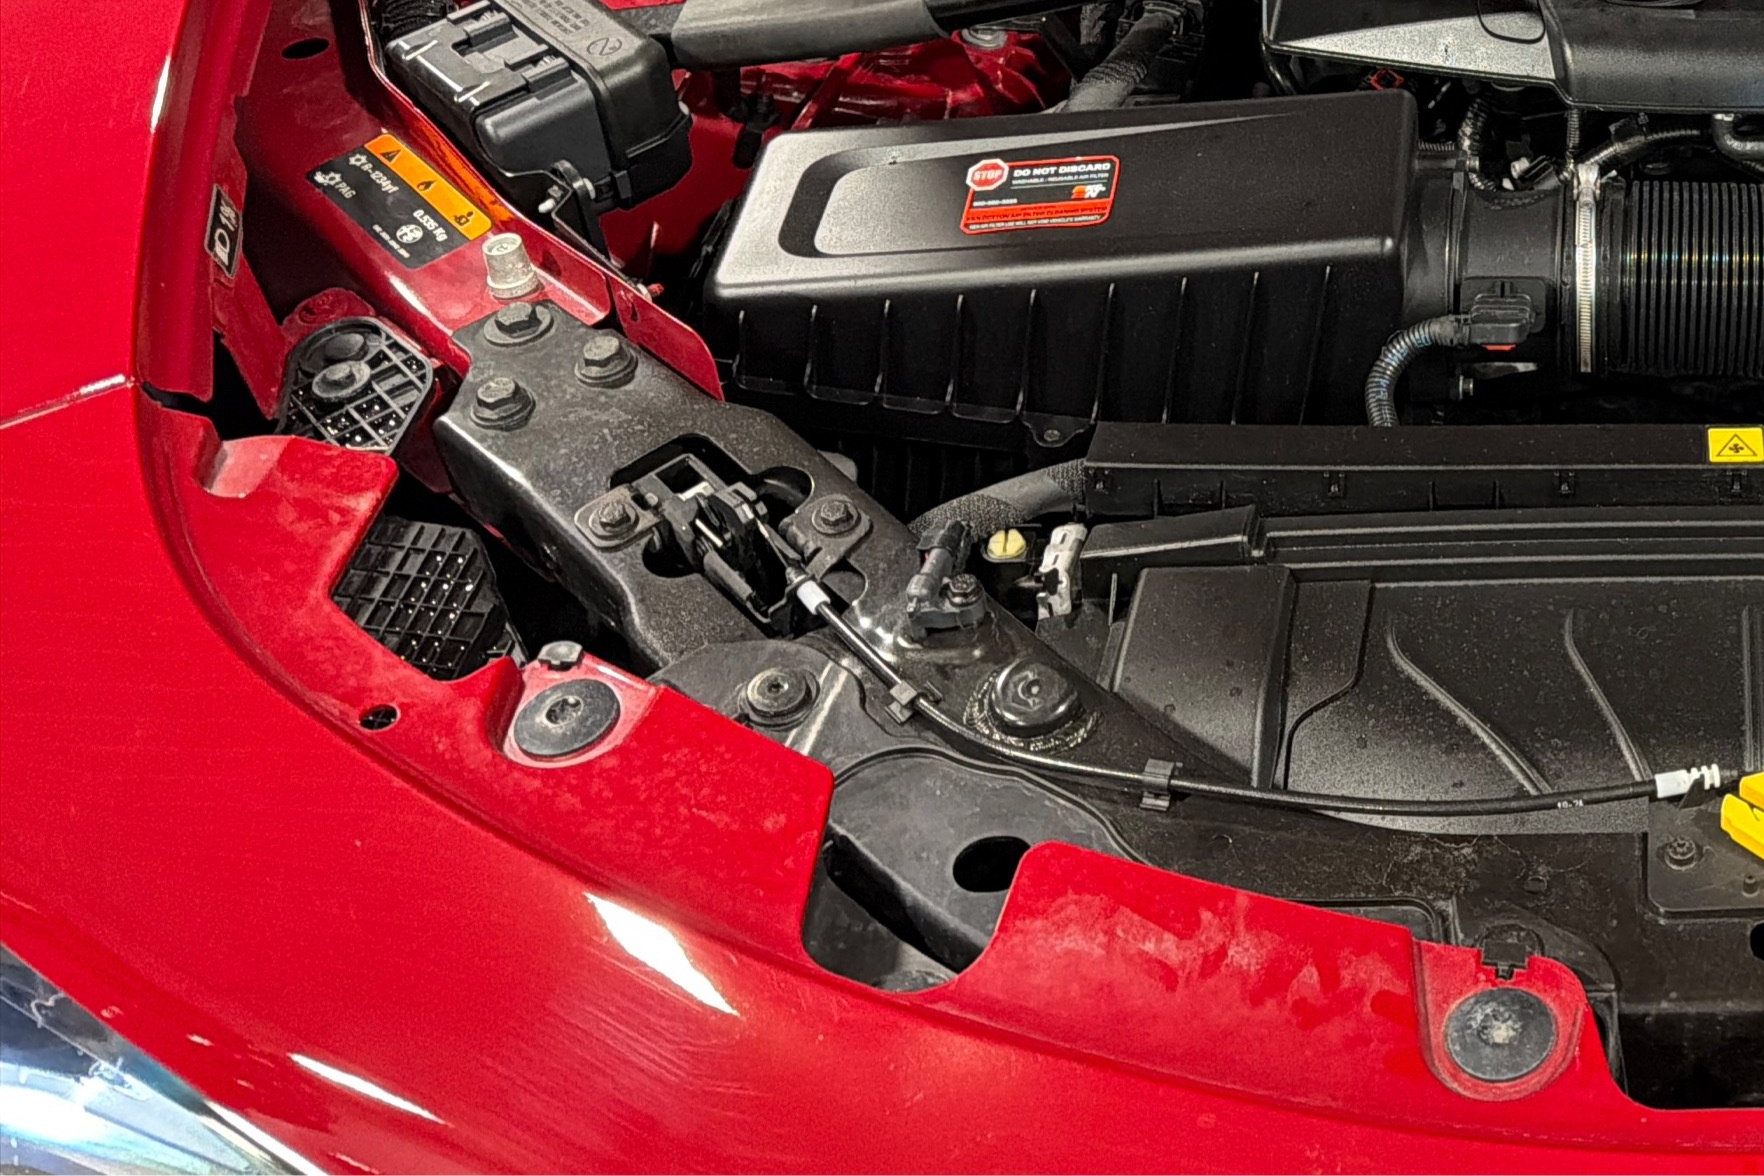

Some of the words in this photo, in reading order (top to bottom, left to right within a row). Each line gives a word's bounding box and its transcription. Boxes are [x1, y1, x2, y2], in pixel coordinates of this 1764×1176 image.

[973, 169, 1003, 181] STOP
[1013, 169, 1031, 177] DO
[1032, 166, 1057, 176] NOT
[1059, 162, 1111, 173] DISCARD
[334, 181, 356, 199] PAG
